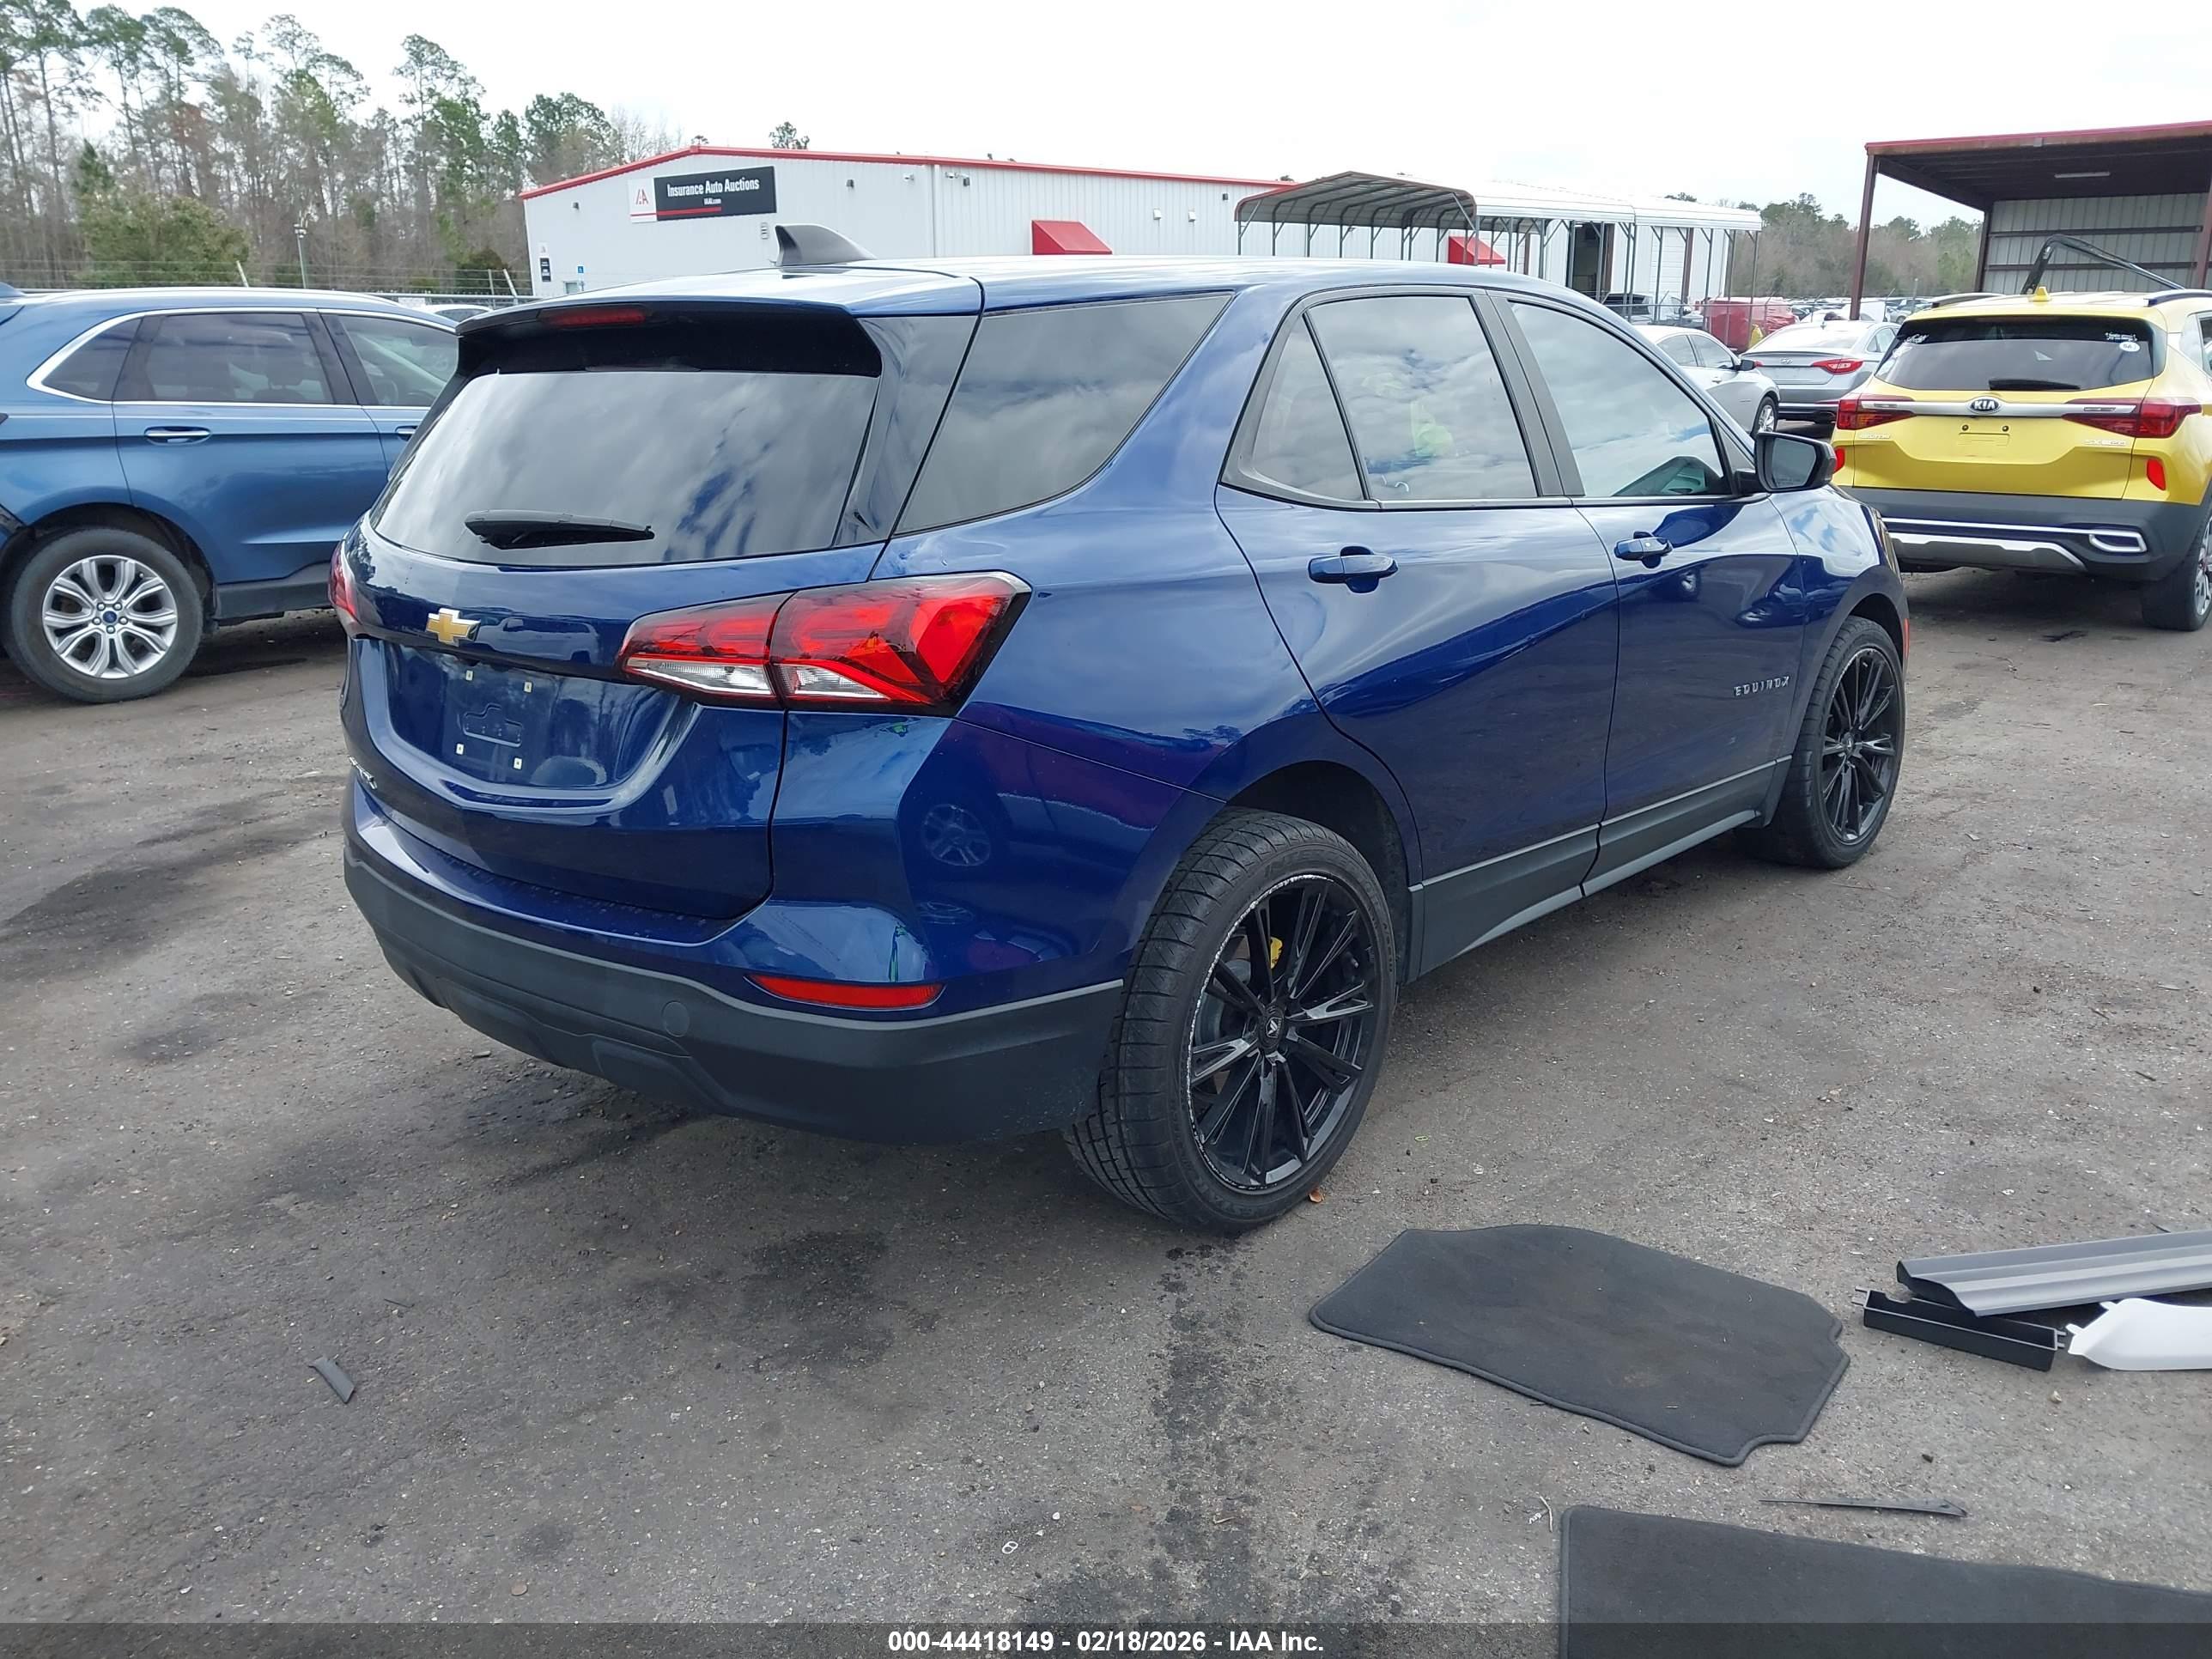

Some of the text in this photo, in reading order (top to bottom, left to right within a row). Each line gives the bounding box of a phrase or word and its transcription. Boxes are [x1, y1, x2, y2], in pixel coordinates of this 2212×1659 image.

[666, 176, 760, 198] Insurance Auto Auctions
[1974, 400, 1996, 410] KIA
[1735, 675, 1790, 697] EQUINOX
